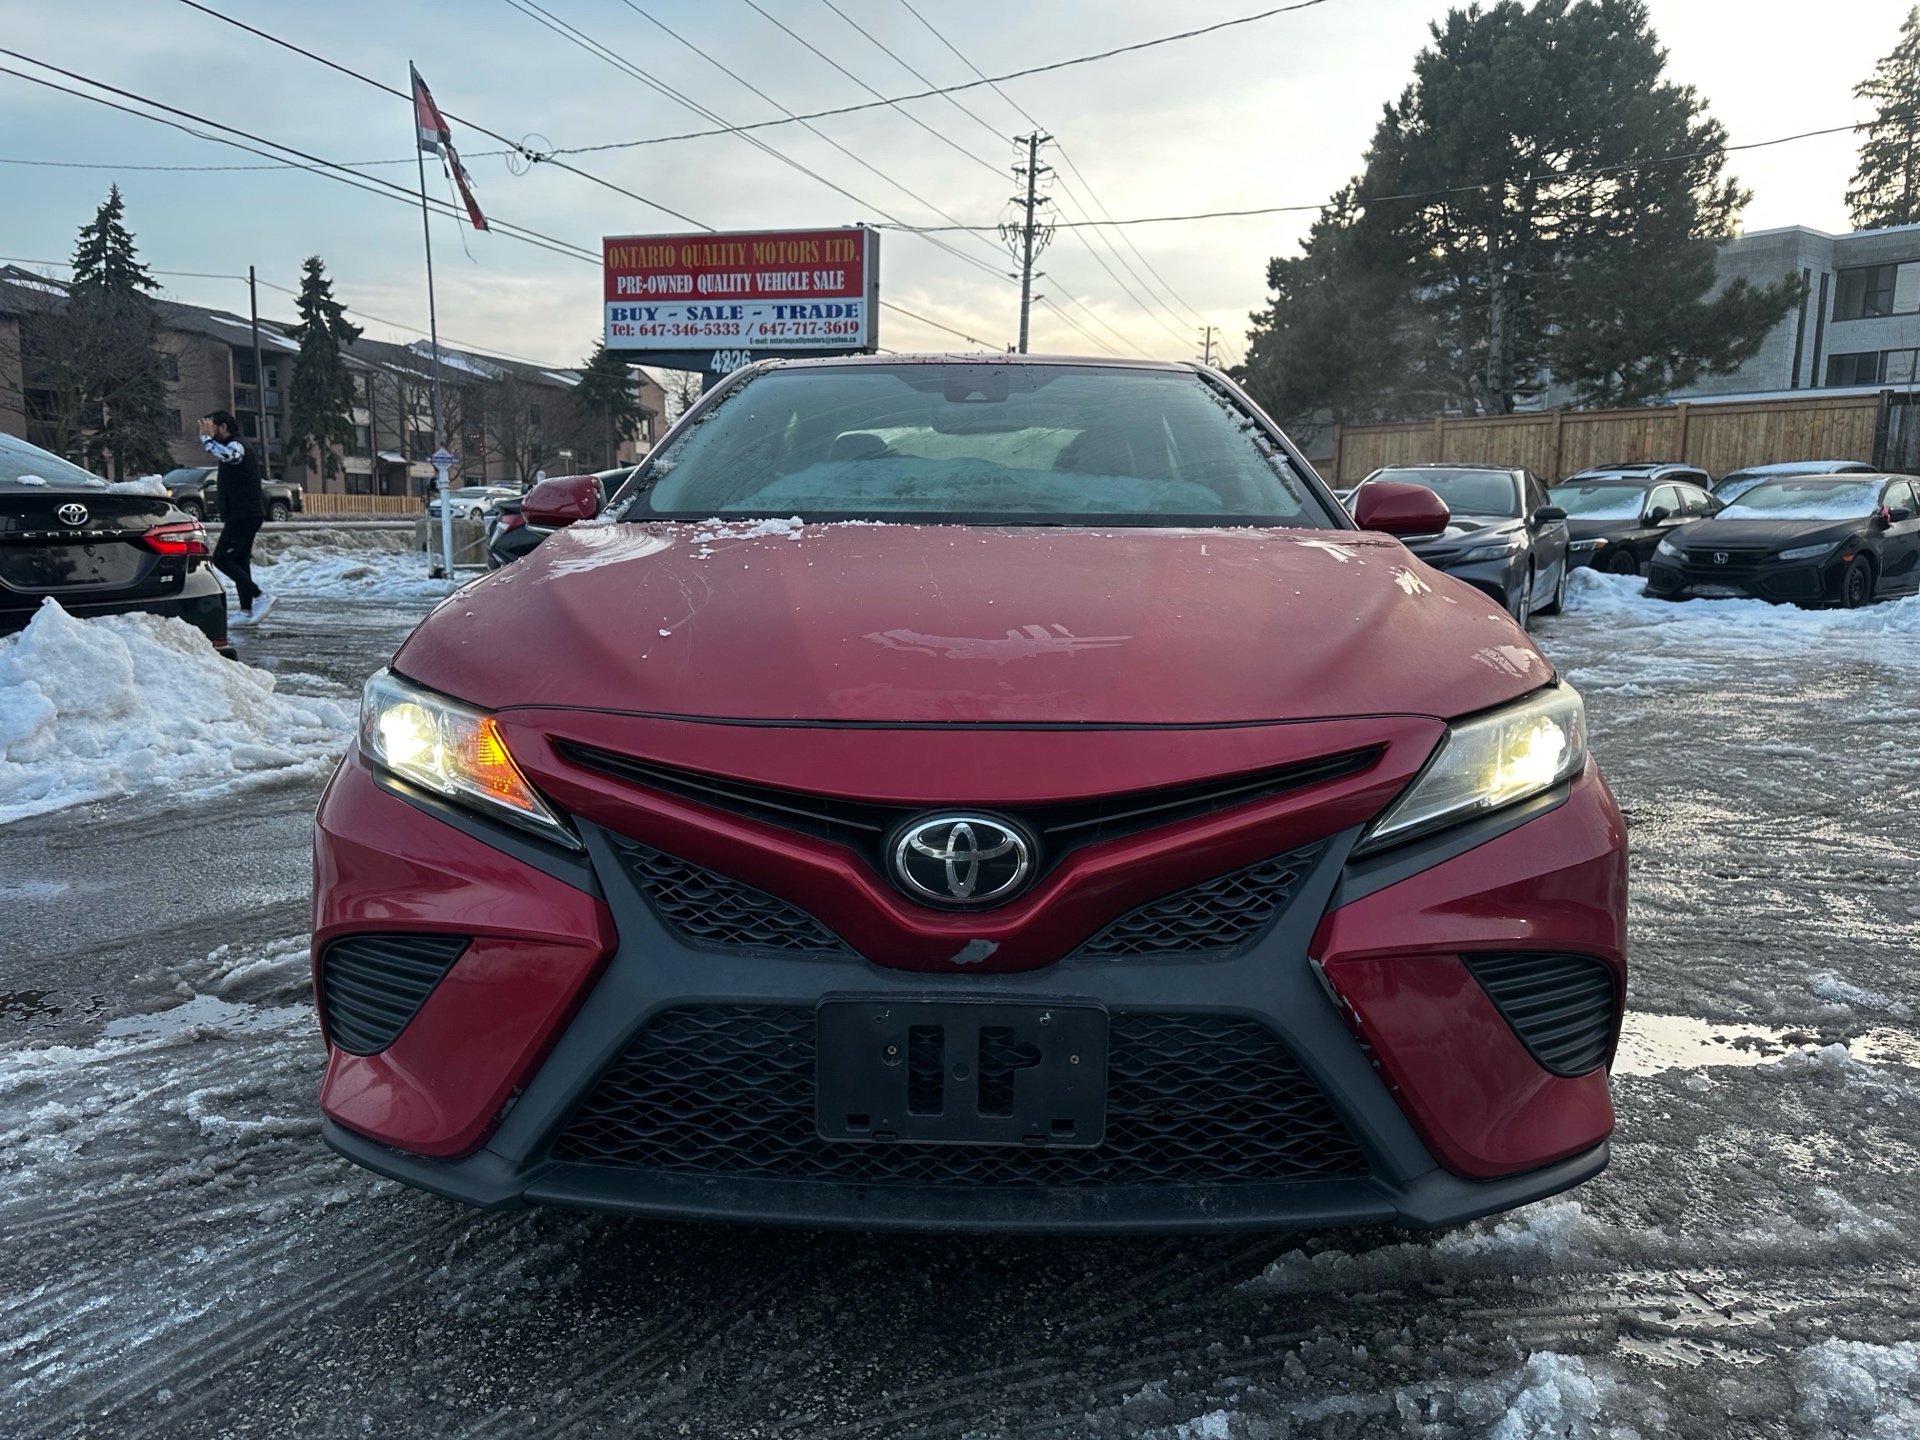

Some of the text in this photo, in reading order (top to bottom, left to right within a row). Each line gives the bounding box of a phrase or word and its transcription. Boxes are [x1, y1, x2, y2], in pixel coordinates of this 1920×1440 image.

[609, 239, 860, 269] ONTARIO QUALITY MOTORS LTD.
[617, 270, 845, 295] PRE-OWNED QUALITY VEHICLE SALE
[611, 307, 659, 321] BUY
[686, 306, 743, 321] SALE
[772, 304, 859, 320] TRADE
[611, 323, 635, 336] Tel:
[639, 322, 740, 336] 647-346-5333
[758, 320, 859, 336] 647-717-3619
